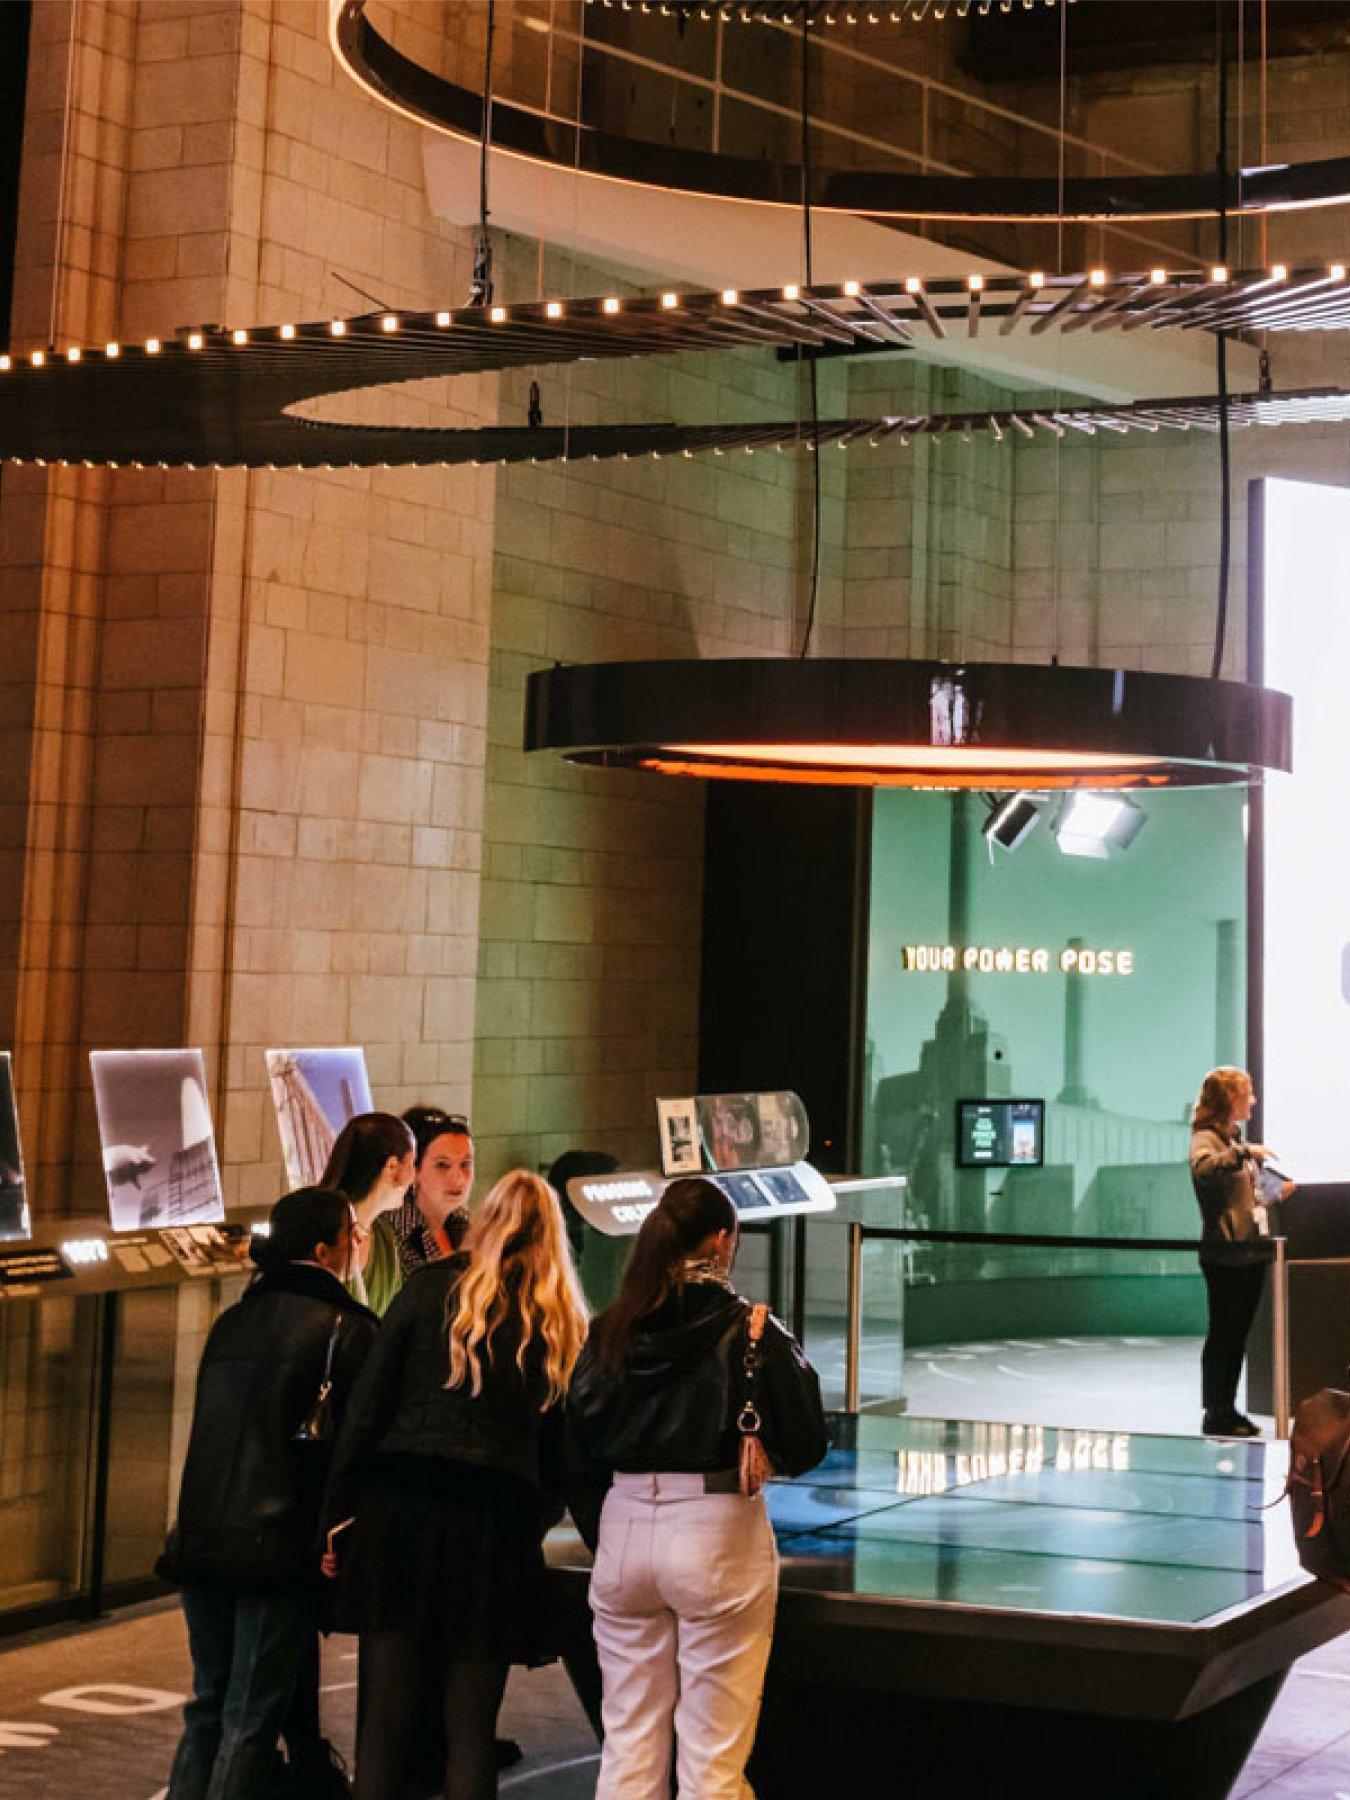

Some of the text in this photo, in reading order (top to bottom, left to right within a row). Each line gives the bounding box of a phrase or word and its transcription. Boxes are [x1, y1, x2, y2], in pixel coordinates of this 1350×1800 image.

[904, 944, 1134, 975] YOUR POWER POSE
